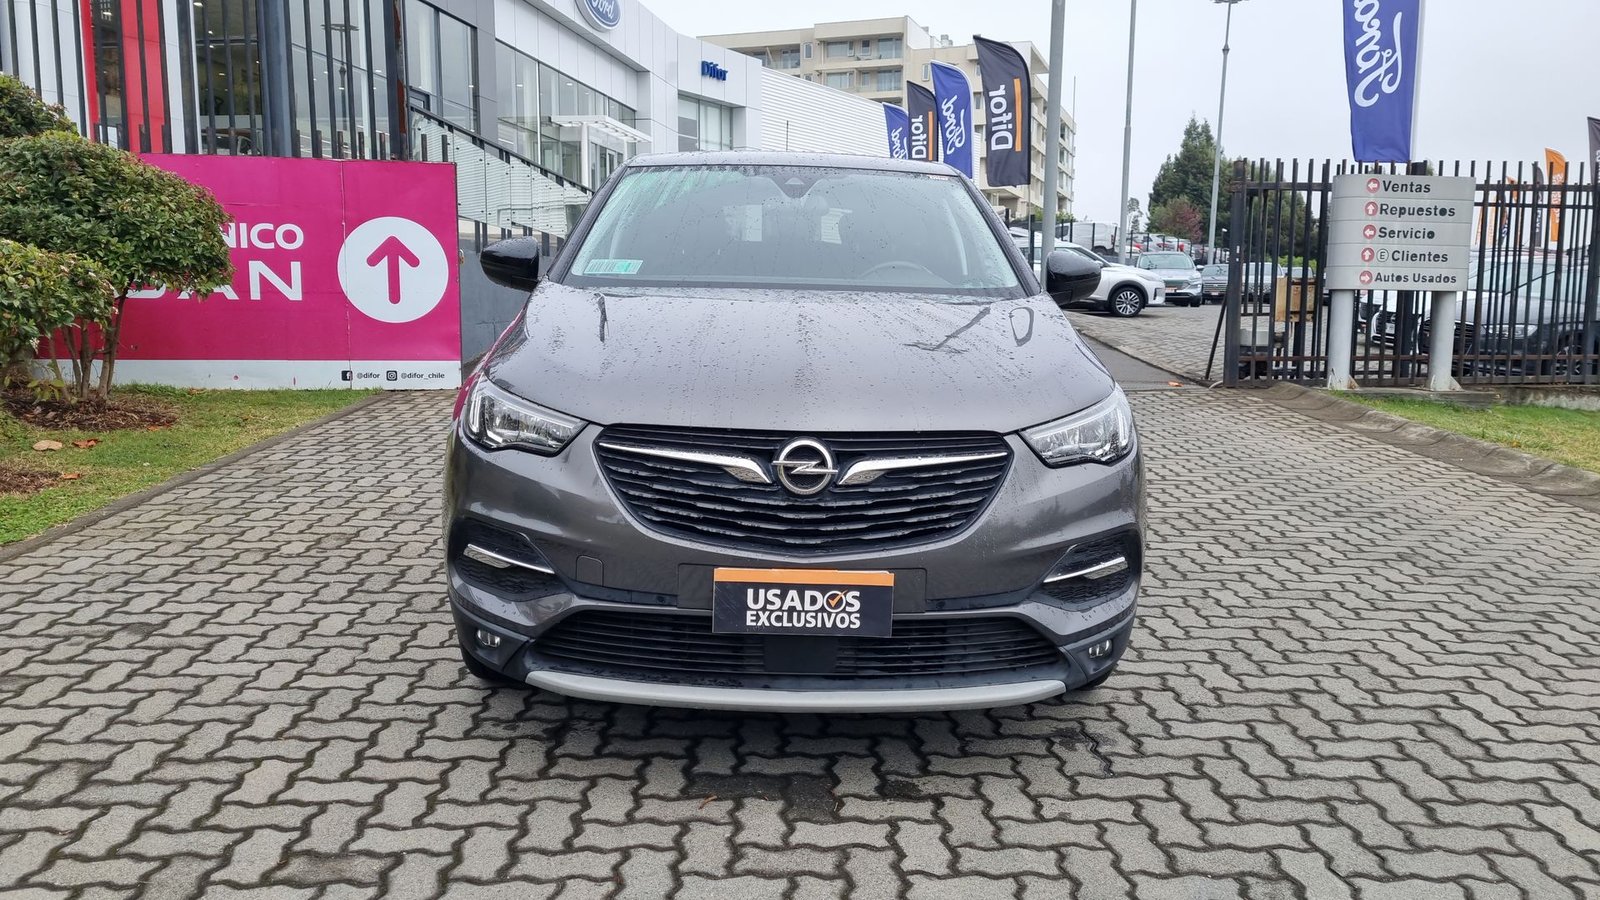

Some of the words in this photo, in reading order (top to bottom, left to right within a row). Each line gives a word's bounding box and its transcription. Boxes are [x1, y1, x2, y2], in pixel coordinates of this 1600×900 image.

[701, 60, 729, 82] Difor
[1382, 180, 1431, 193] Ventas
[1379, 203, 1456, 218] Repuestos
[1378, 226, 1435, 239] Servicio
[1391, 250, 1448, 262] Clientes
[1374, 272, 1409, 283] Autos
[1413, 273, 1457, 284] Usados
[357, 371, 380, 379] @difor
[401, 371, 445, 380] @difor_chile
[746, 589, 861, 613] USADOS
[746, 610, 861, 629] EXCLUSIVOS
